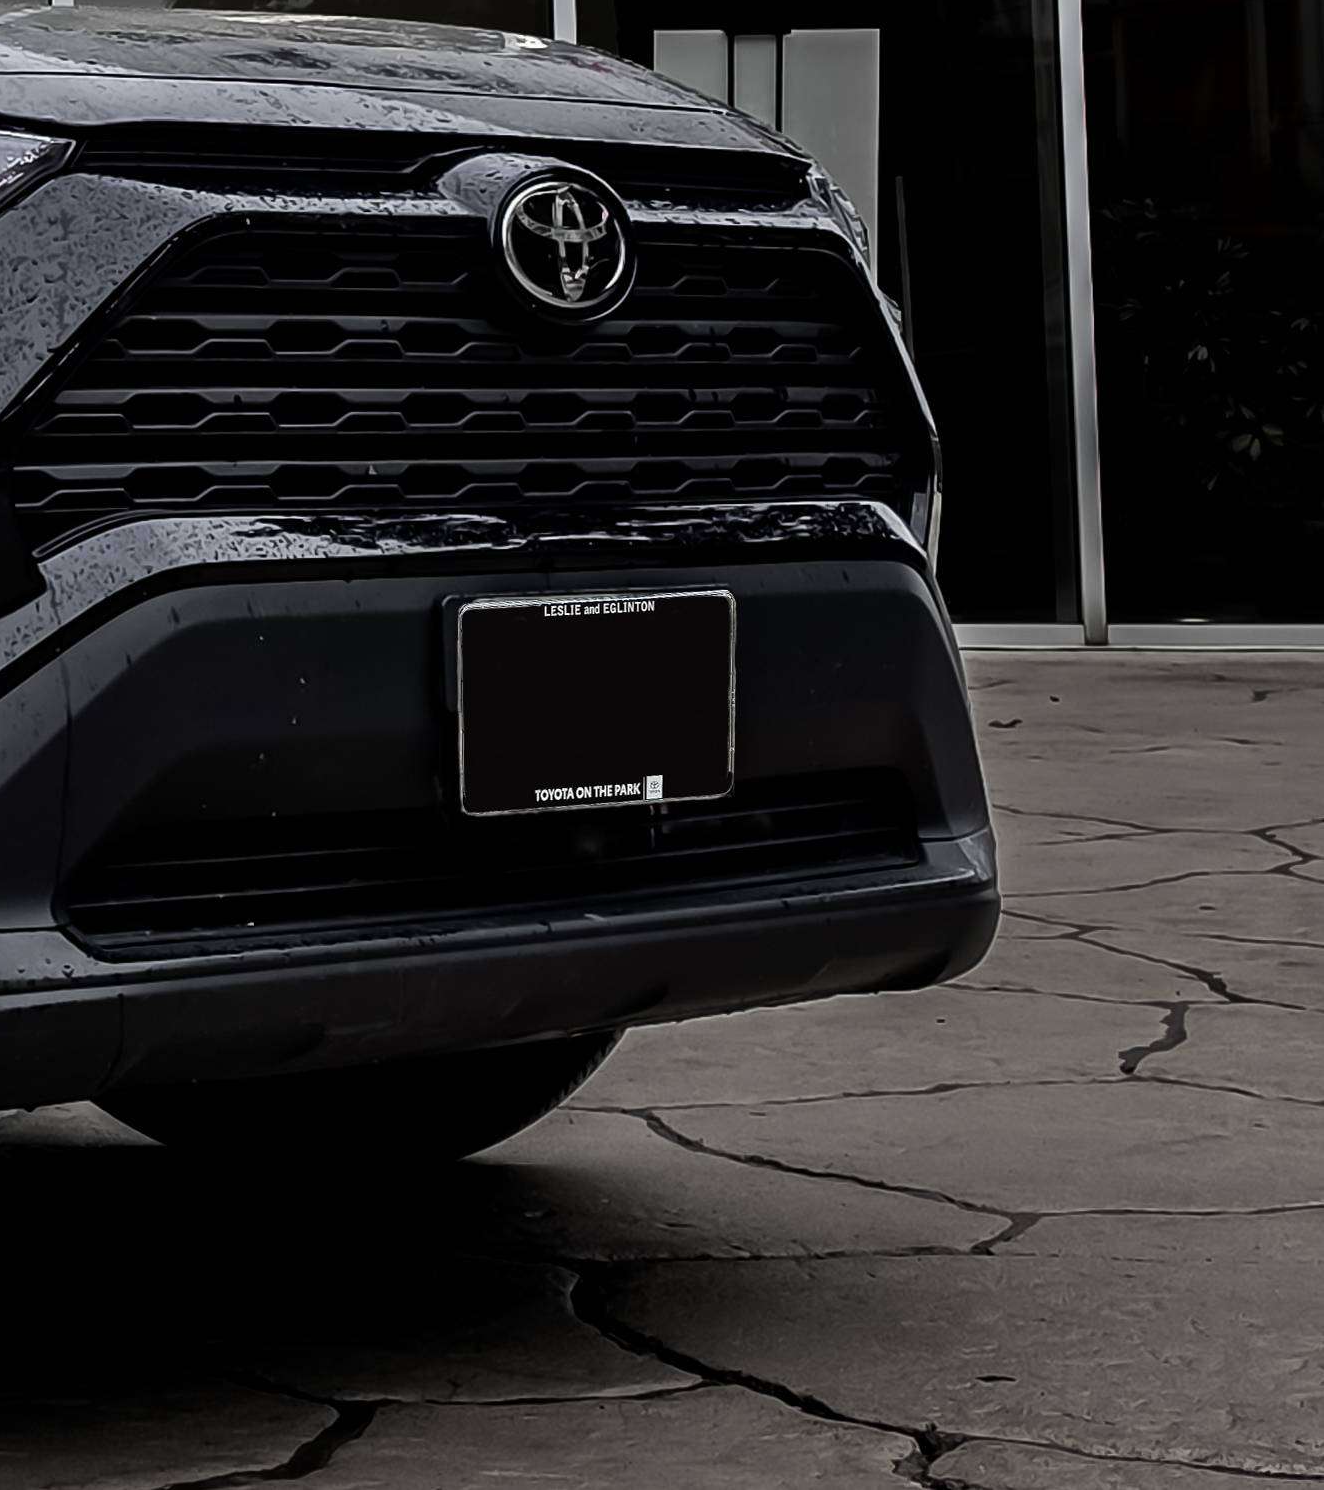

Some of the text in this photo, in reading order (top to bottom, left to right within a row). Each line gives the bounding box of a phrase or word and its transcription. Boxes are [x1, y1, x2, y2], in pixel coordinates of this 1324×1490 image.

[544, 601, 655, 617] LESLIE and EGLINTON
[535, 787, 575, 802] TOYOTA
[576, 786, 592, 799] ON
[593, 785, 613, 798] THE
[614, 783, 641, 796] PARK
